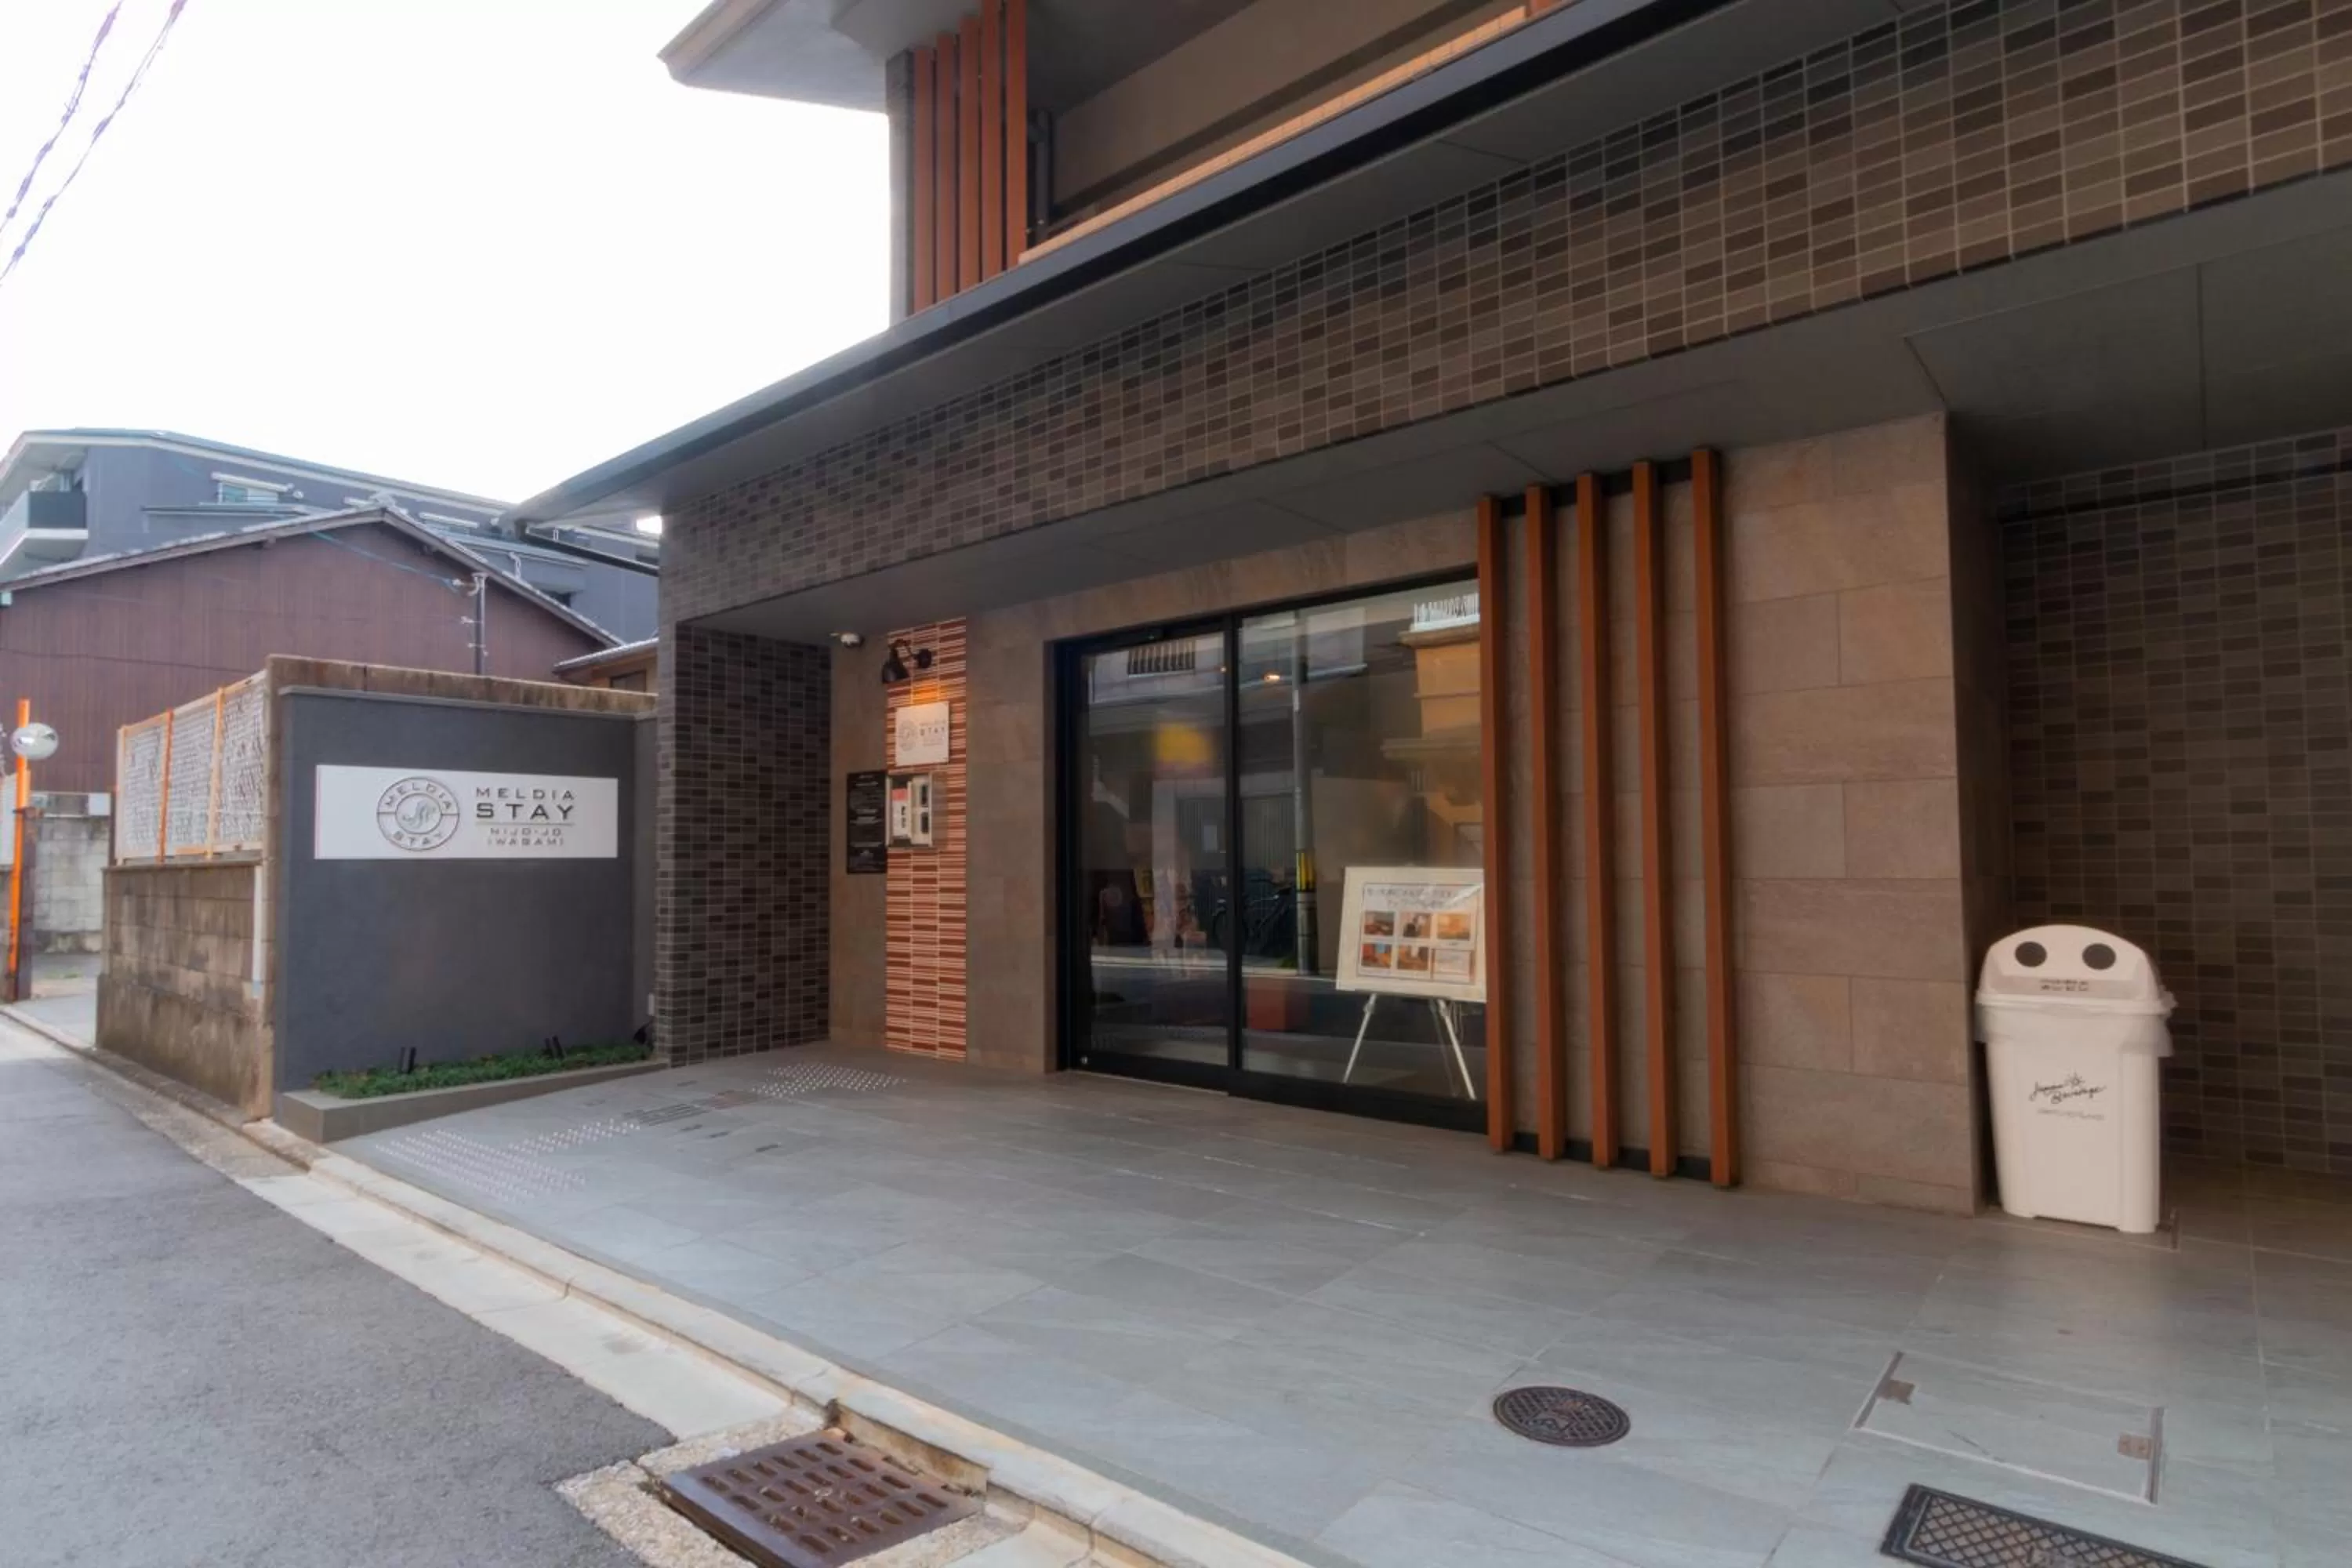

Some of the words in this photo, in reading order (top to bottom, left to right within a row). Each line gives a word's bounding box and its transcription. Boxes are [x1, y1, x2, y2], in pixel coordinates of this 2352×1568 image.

[384, 782, 452, 809] MELDIA
[476, 787, 575, 800] MELDIA
[476, 802, 574, 820] STAY
